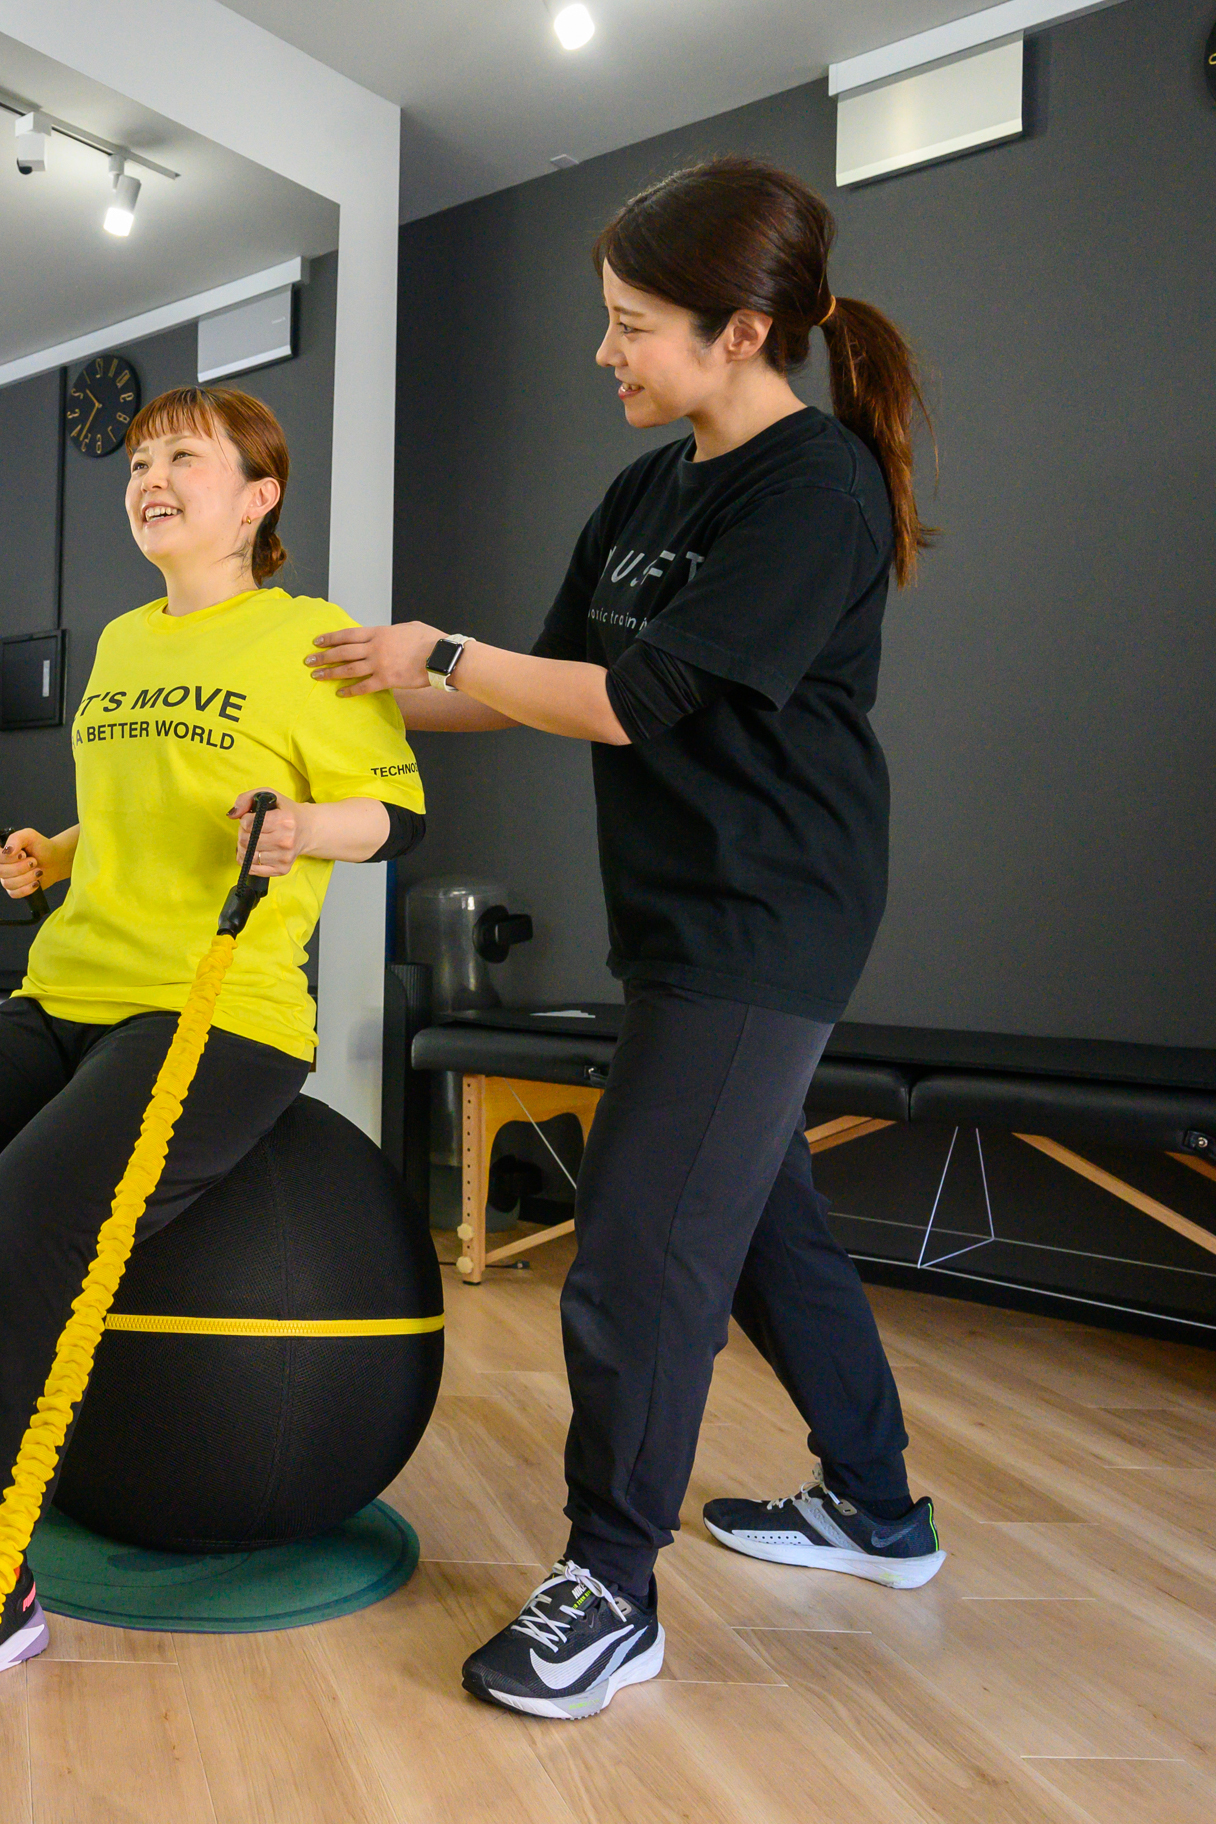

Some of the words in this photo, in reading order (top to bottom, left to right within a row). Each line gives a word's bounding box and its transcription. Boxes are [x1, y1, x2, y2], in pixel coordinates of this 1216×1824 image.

[80, 691, 127, 717] T'S
[130, 685, 247, 723] MOVE
[76, 729, 84, 747] A
[86, 720, 150, 743] BETTER
[155, 719, 235, 751] WORLD
